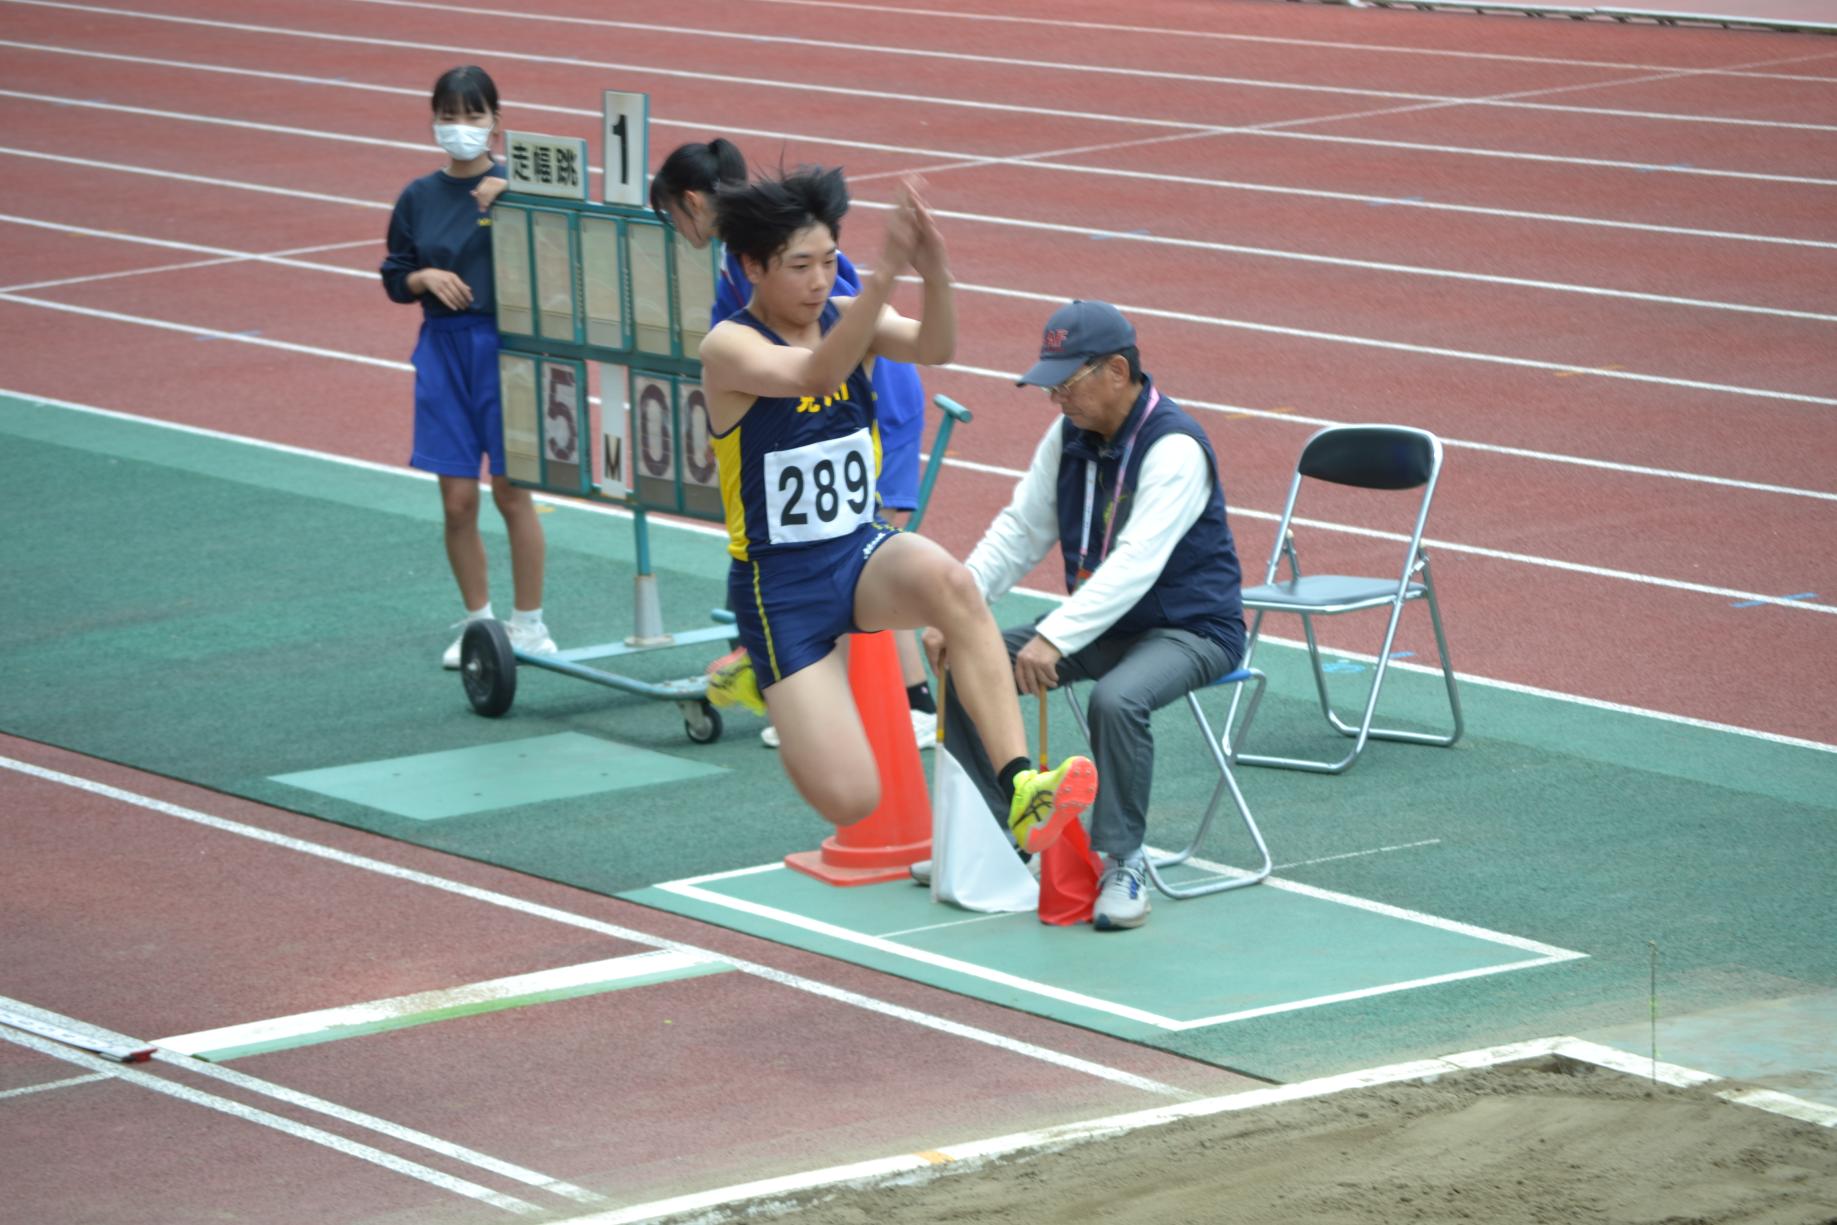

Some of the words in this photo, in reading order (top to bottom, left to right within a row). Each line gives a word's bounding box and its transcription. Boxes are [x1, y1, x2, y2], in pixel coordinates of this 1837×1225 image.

[612, 114, 629, 185] 1
[548, 366, 577, 461] 5
[604, 433, 622, 482] M
[778, 450, 869, 527] 289
